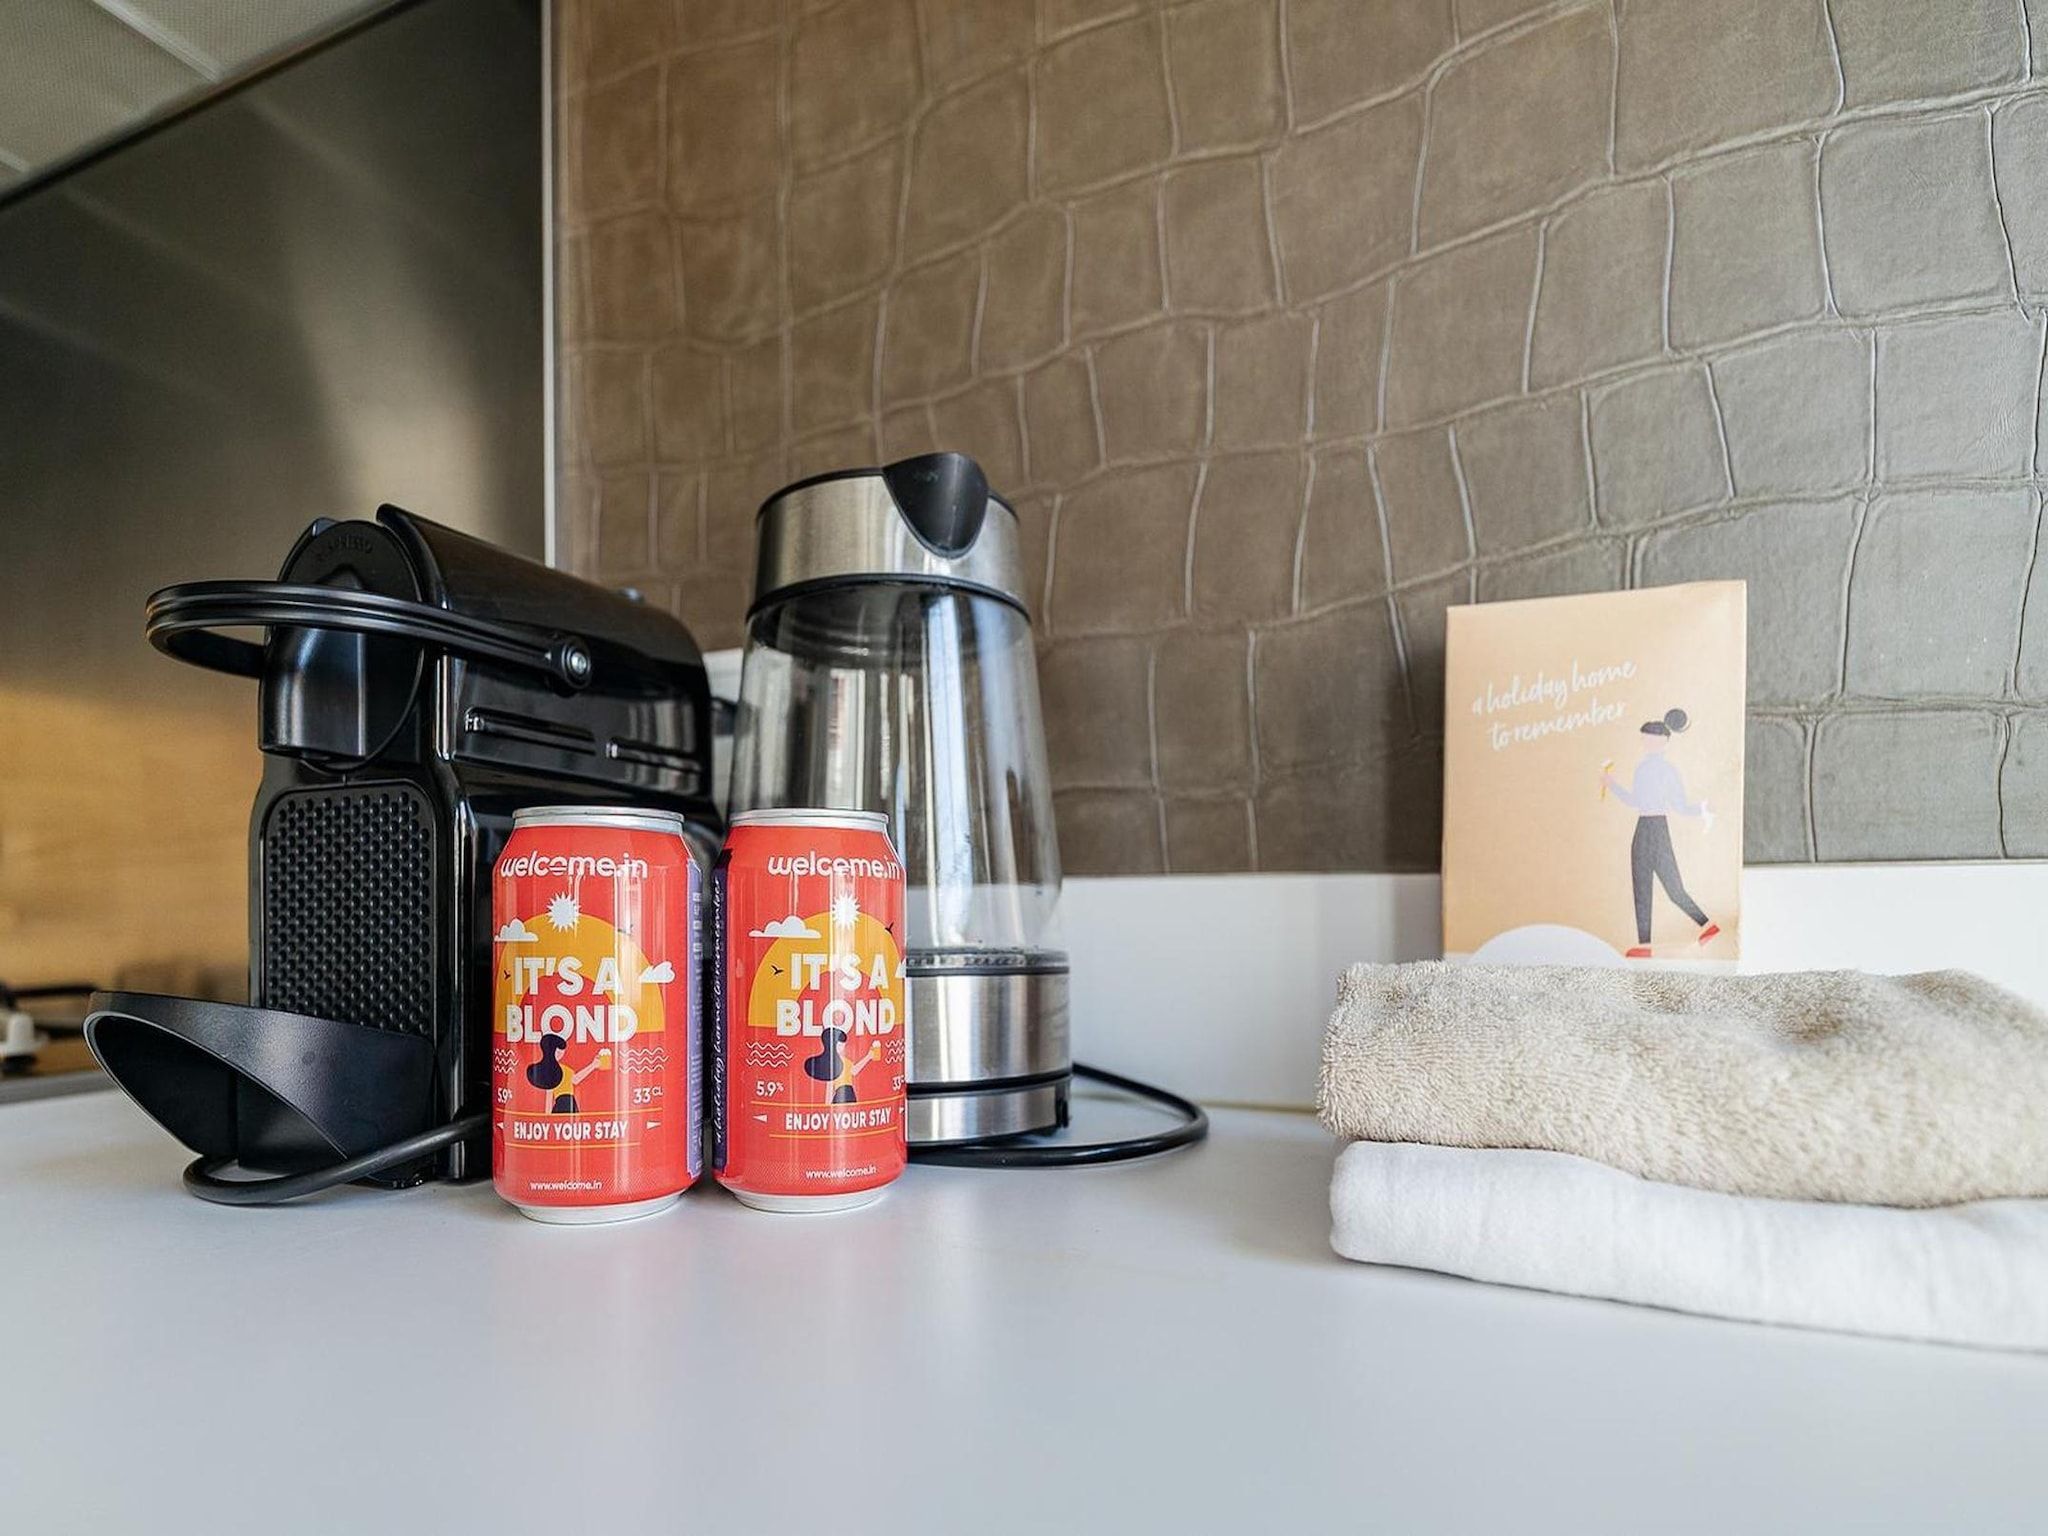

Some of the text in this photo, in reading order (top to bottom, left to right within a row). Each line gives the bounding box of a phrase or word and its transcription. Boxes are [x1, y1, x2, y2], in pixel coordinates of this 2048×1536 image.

[1487, 669, 1568, 711] holiday
[1571, 656, 1638, 692] home
[1488, 696, 1628, 751] to remember
[514, 956, 625, 996] IT'S A
[790, 952, 889, 992] IT'S A
[506, 1003, 639, 1044] BLOND
[776, 998, 896, 1037] BLOND
[756, 1080, 784, 1097] 5.9%
[513, 1120, 629, 1140] ENJOY YOUR STAY
[785, 1107, 892, 1131] ENJOY YOUR STAY
[529, 1179, 603, 1191] www.welcome.in
[805, 1164, 877, 1179] www.welcome.in
